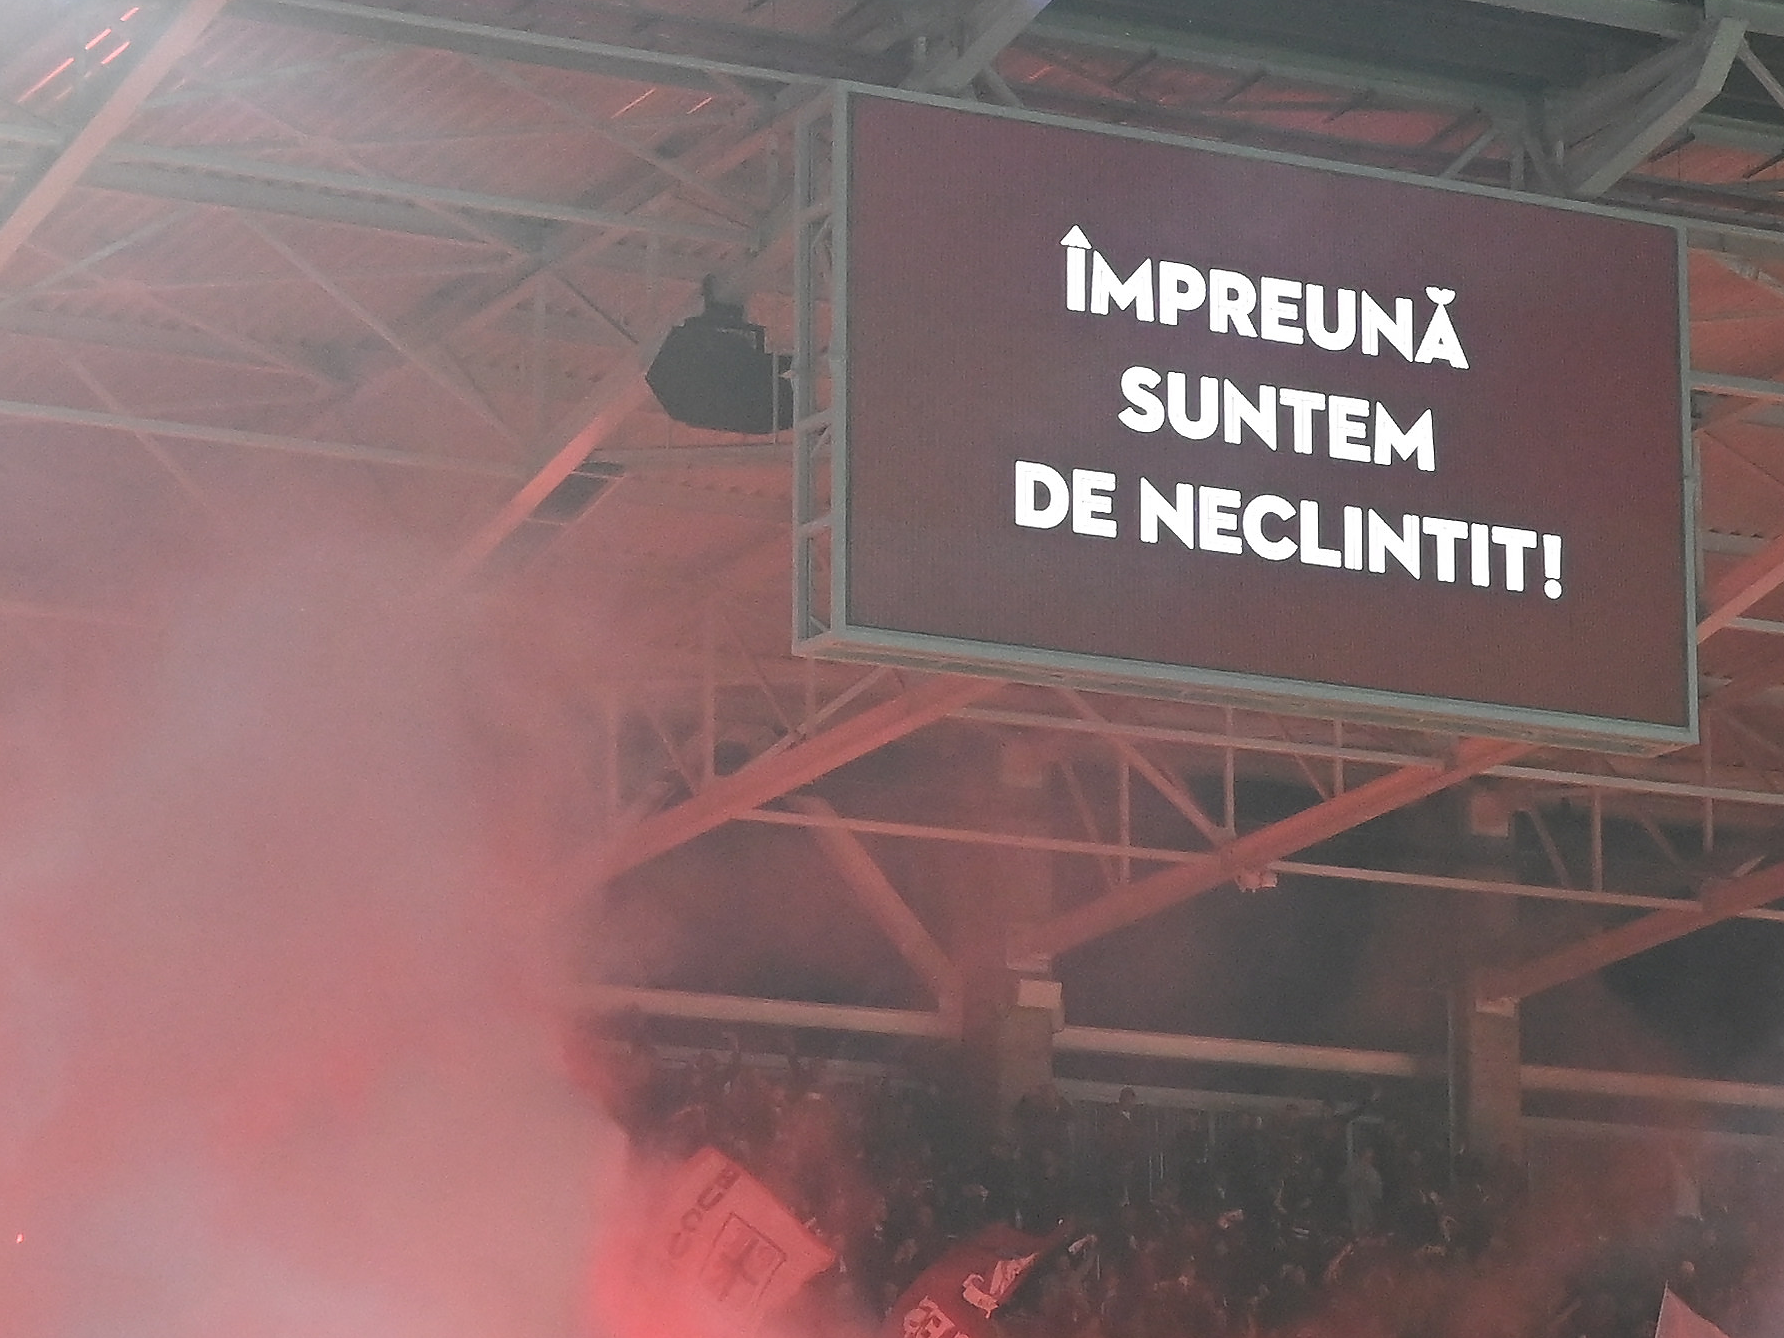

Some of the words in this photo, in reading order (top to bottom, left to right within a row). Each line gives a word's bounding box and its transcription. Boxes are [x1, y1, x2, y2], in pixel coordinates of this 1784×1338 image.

[1060, 226, 1470, 370] ÎMPREUNĂ
[1118, 366, 1436, 472] SUNTEM
[1015, 460, 1118, 538] DE
[1139, 477, 1563, 600] NECLINTIT!
